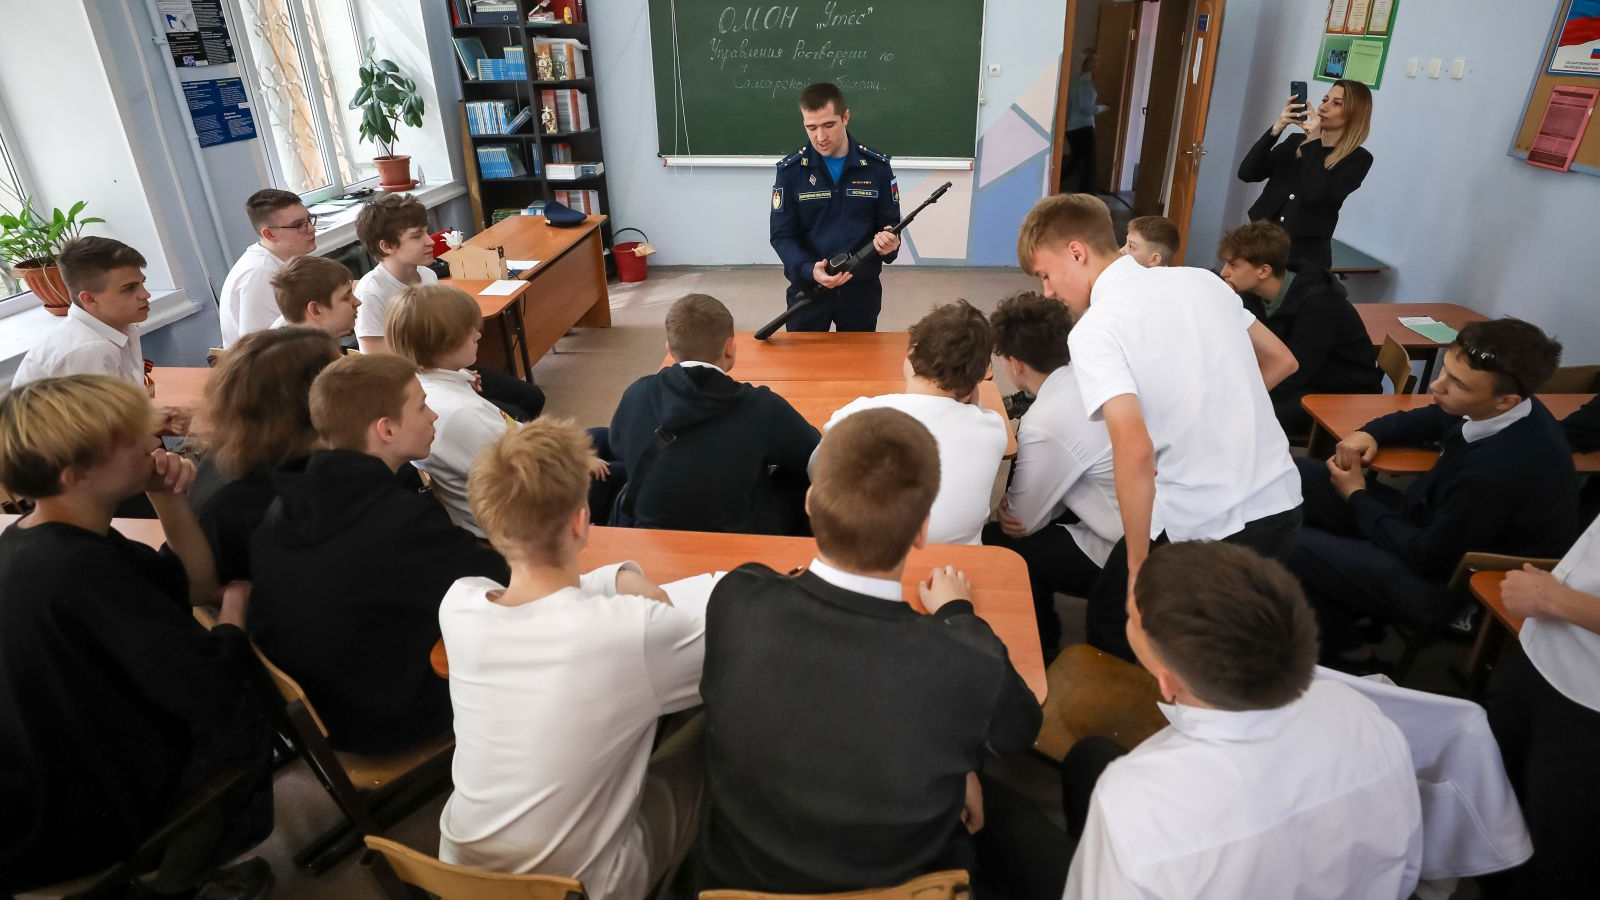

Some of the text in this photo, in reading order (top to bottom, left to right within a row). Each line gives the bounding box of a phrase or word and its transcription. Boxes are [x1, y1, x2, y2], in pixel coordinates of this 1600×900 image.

[718, 6, 799, 34] ОМОН
[709, 37, 895, 71] Управления Росгвардии по
[831, 74, 888, 92] бласти.
